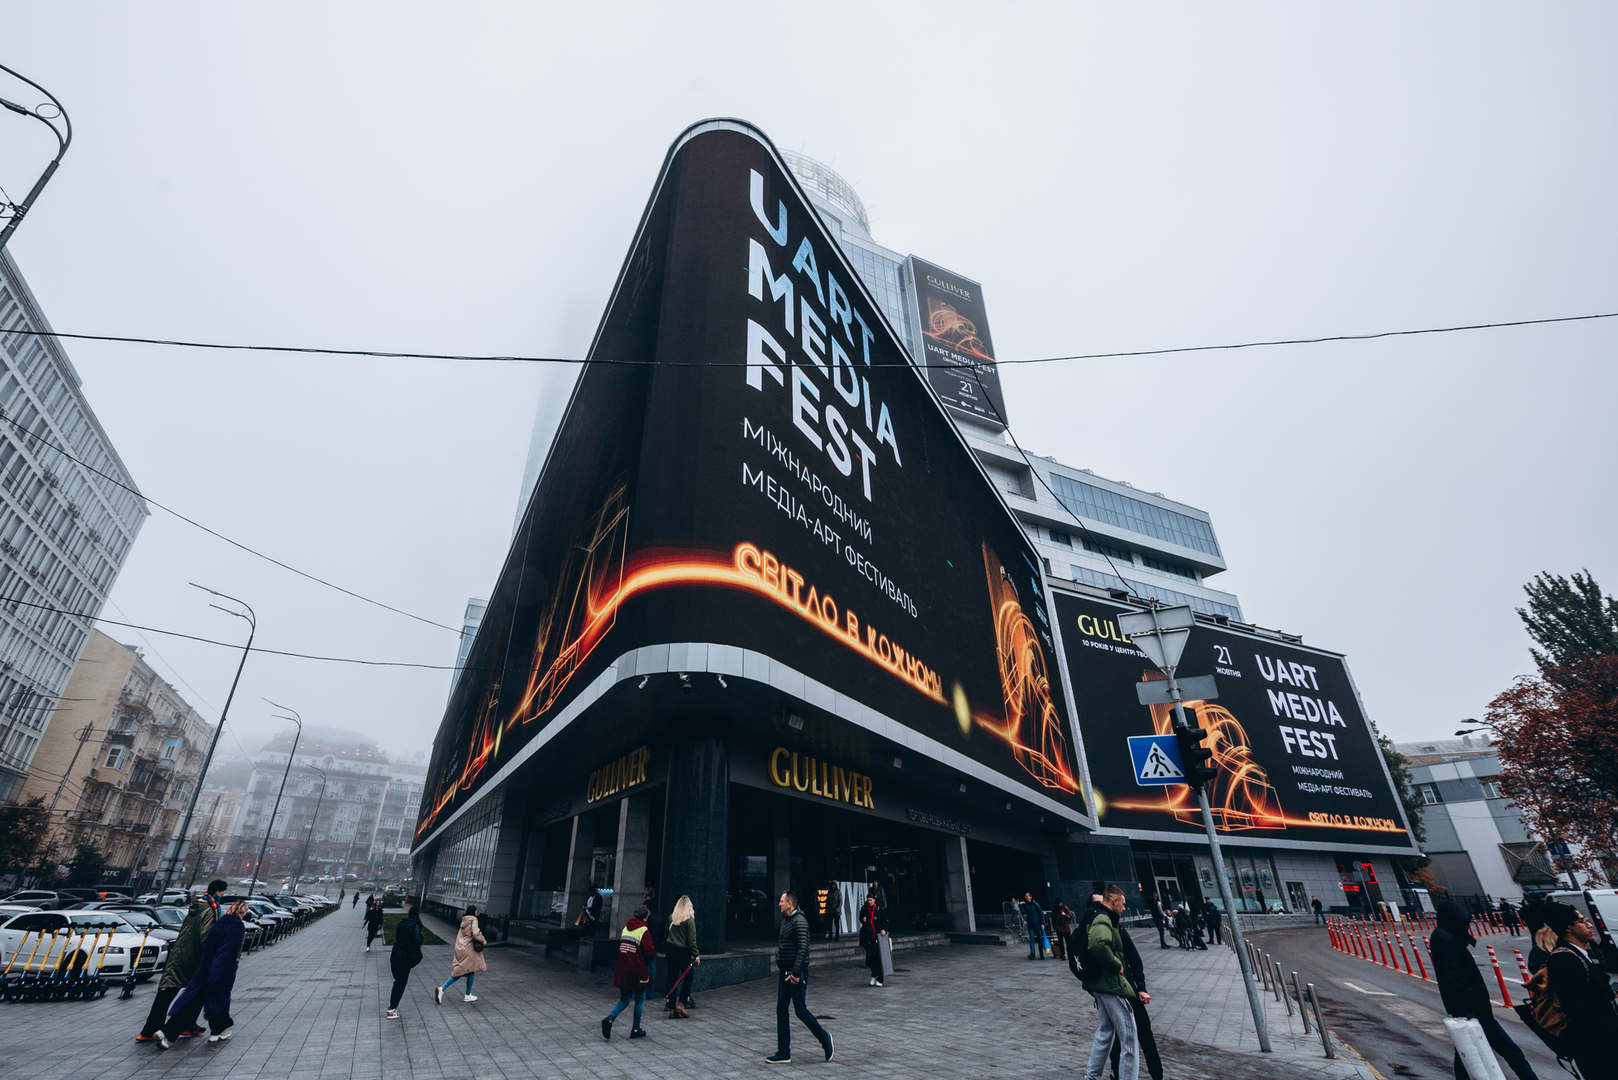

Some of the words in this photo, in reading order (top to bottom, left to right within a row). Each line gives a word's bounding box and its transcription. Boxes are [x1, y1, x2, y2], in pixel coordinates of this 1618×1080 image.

[750, 168, 875, 369] UART
[926, 274, 970, 299] GULLIVER
[748, 237, 902, 468] MEDIA
[927, 343, 949, 357] UART
[951, 352, 976, 367] MEDIA
[977, 362, 996, 375] FEST
[960, 380, 973, 394] 21
[746, 318, 877, 503] FEST
[743, 417, 873, 545] МІЖНАРОДНИЙ
[742, 462, 842, 554] МЕДІА-АРТ
[845, 545, 918, 619] ФЕСТИВАЛЬ
[735, 542, 839, 628] СВІТЛО
[846, 609, 860, 643] В
[867, 624, 943, 697] КОЖНОМУ
[1077, 614, 1152, 645] GULL
[1082, 639, 1090, 647] 10
[1090, 641, 1109, 651] РОКІВ
[1115, 646, 1136, 656] ЦЕНТРІ
[1136, 650, 1149, 659] ТВО
[1213, 644, 1233, 666] 21
[1254, 654, 1319, 691] UART
[1266, 688, 1347, 728] MEDIA
[1279, 725, 1339, 760] FEST
[587, 745, 651, 804] GULLIVER
[767, 746, 875, 810] GULLIVER
[1291, 765, 1345, 780] МІЖНАРОДНИЙ
[1297, 781, 1334, 794] МЕДІА-АРТ
[1334, 786, 1373, 799] ФЕСТИВАЛЬ
[1308, 811, 1342, 827] СВІТЛО
[1343, 814, 1352, 828] В
[1353, 815, 1397, 831] КОЖНОМУ
